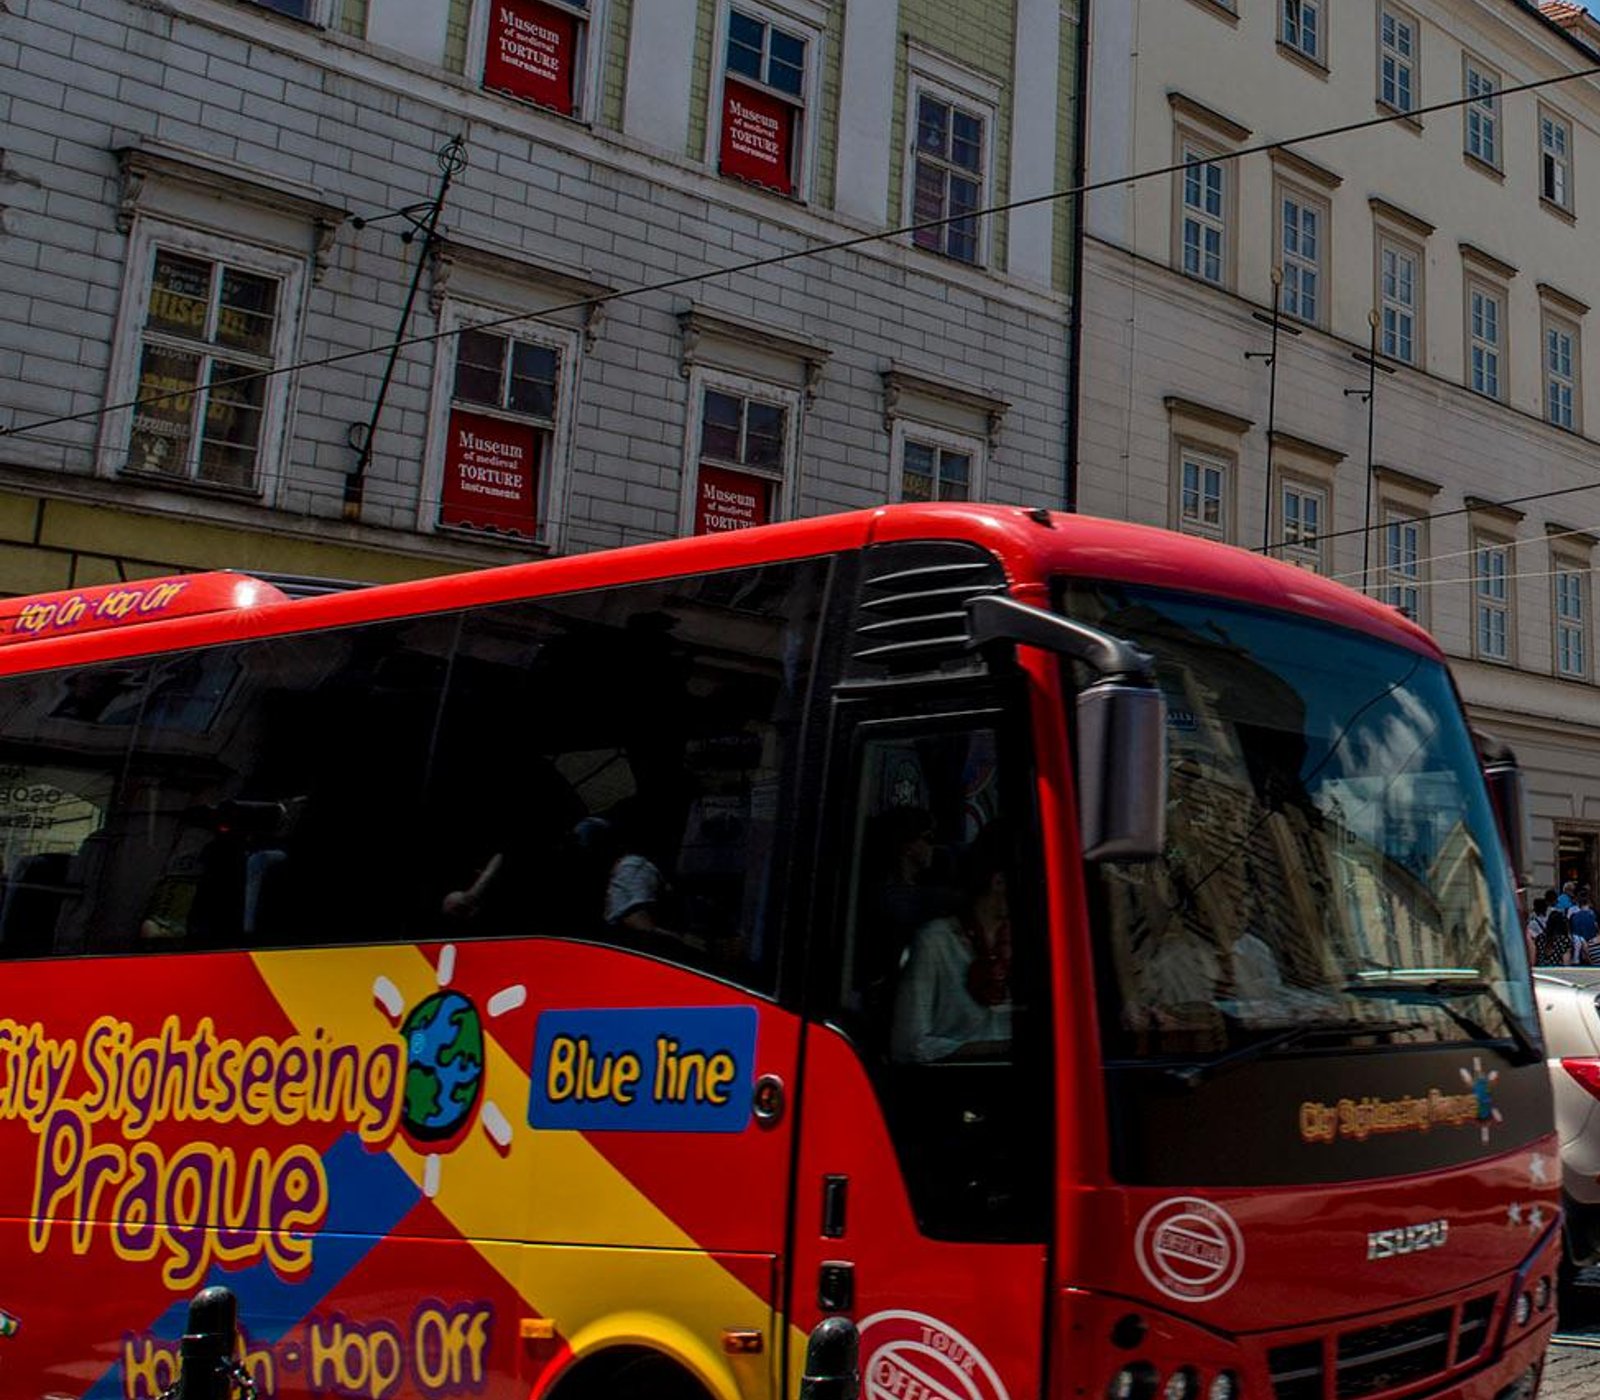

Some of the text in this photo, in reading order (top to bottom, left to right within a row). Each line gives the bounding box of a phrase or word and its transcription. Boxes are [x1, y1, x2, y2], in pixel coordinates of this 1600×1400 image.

[500, 7, 560, 45] Museum
[499, 36, 560, 71] TORTURE
[729, 99, 779, 131] Museum
[729, 126, 779, 156] TORTURE
[459, 430, 523, 459] Museum
[463, 451, 518, 470] of medieval
[458, 463, 523, 489] TORTURE
[703, 483, 756, 508] Museum
[15, 603, 57, 632] Hop
[56, 596, 86, 626] On
[96, 591, 143, 619] Hop
[140, 581, 188, 612] Off
[82, 1015, 408, 1143] Sightseeing
[547, 1035, 737, 1105] Blue line
[29, 1100, 328, 1290] Prague
[1367, 1219, 1449, 1260] ISUZU
[125, 1340, 184, 1400] Ho
[311, 1322, 401, 1400] Hop
[416, 1309, 491, 1389] Off
[920, 1326, 976, 1377] TOUR
